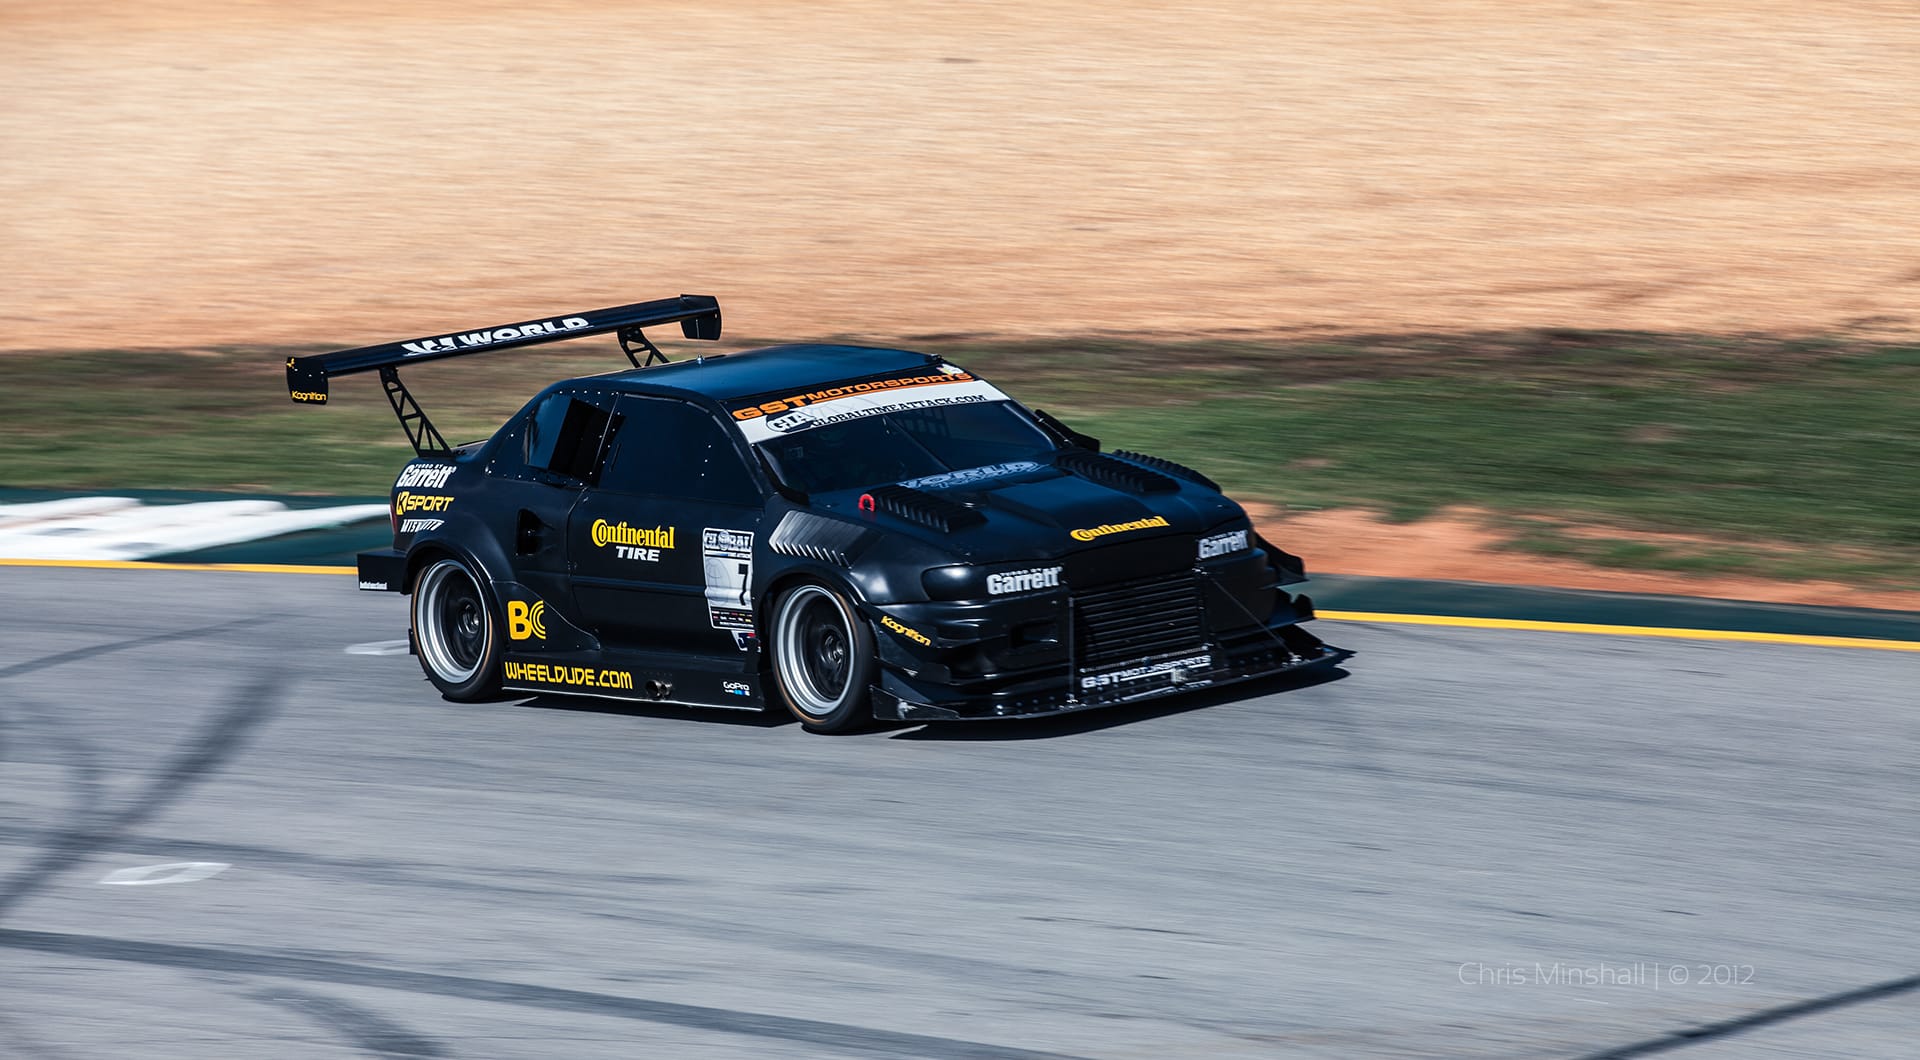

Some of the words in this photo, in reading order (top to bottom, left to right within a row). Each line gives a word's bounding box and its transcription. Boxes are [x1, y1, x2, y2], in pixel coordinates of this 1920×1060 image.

[291, 391, 327, 401] Kognition
[732, 396, 813, 420] GST
[805, 373, 974, 401] MOTORSPORTS
[396, 464, 457, 489] Garrett
[591, 518, 675, 549] Continental
[1070, 515, 1170, 541] Continental
[615, 545, 661, 562] TIRE
[1198, 530, 1249, 559] Garrett
[738, 563, 749, 606] 7
[986, 566, 1063, 595] Garrett
[880, 615, 932, 647] Kognition
[504, 661, 633, 690] WHEELDUDE.COM
[723, 681, 750, 691] GoPro
[1081, 671, 1121, 689] GST
